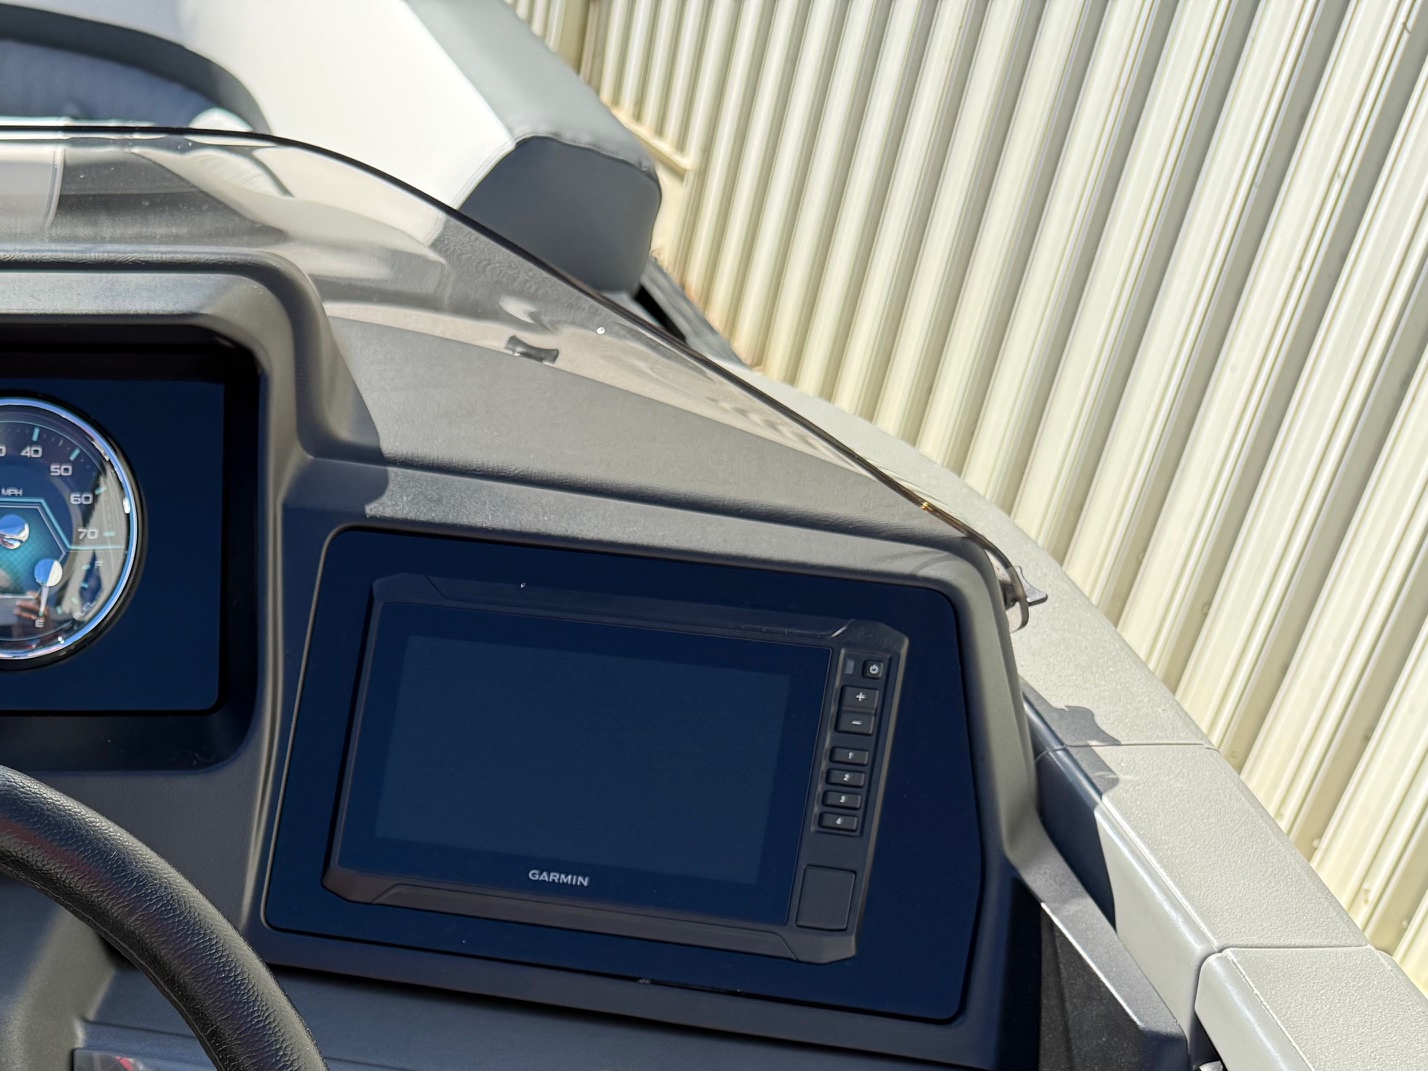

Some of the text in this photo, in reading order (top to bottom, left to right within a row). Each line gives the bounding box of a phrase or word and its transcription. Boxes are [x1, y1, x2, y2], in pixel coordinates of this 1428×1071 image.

[20, 446, 43, 458] 40
[49, 465, 72, 476] 50
[0, 488, 23, 497] MPH
[69, 493, 93, 505] 60
[77, 528, 99, 540] 70
[34, 619, 45, 628] E
[842, 773, 851, 782] 2
[838, 794, 847, 803] 3
[834, 816, 844, 826] 4
[527, 868, 591, 888] GARMIN
